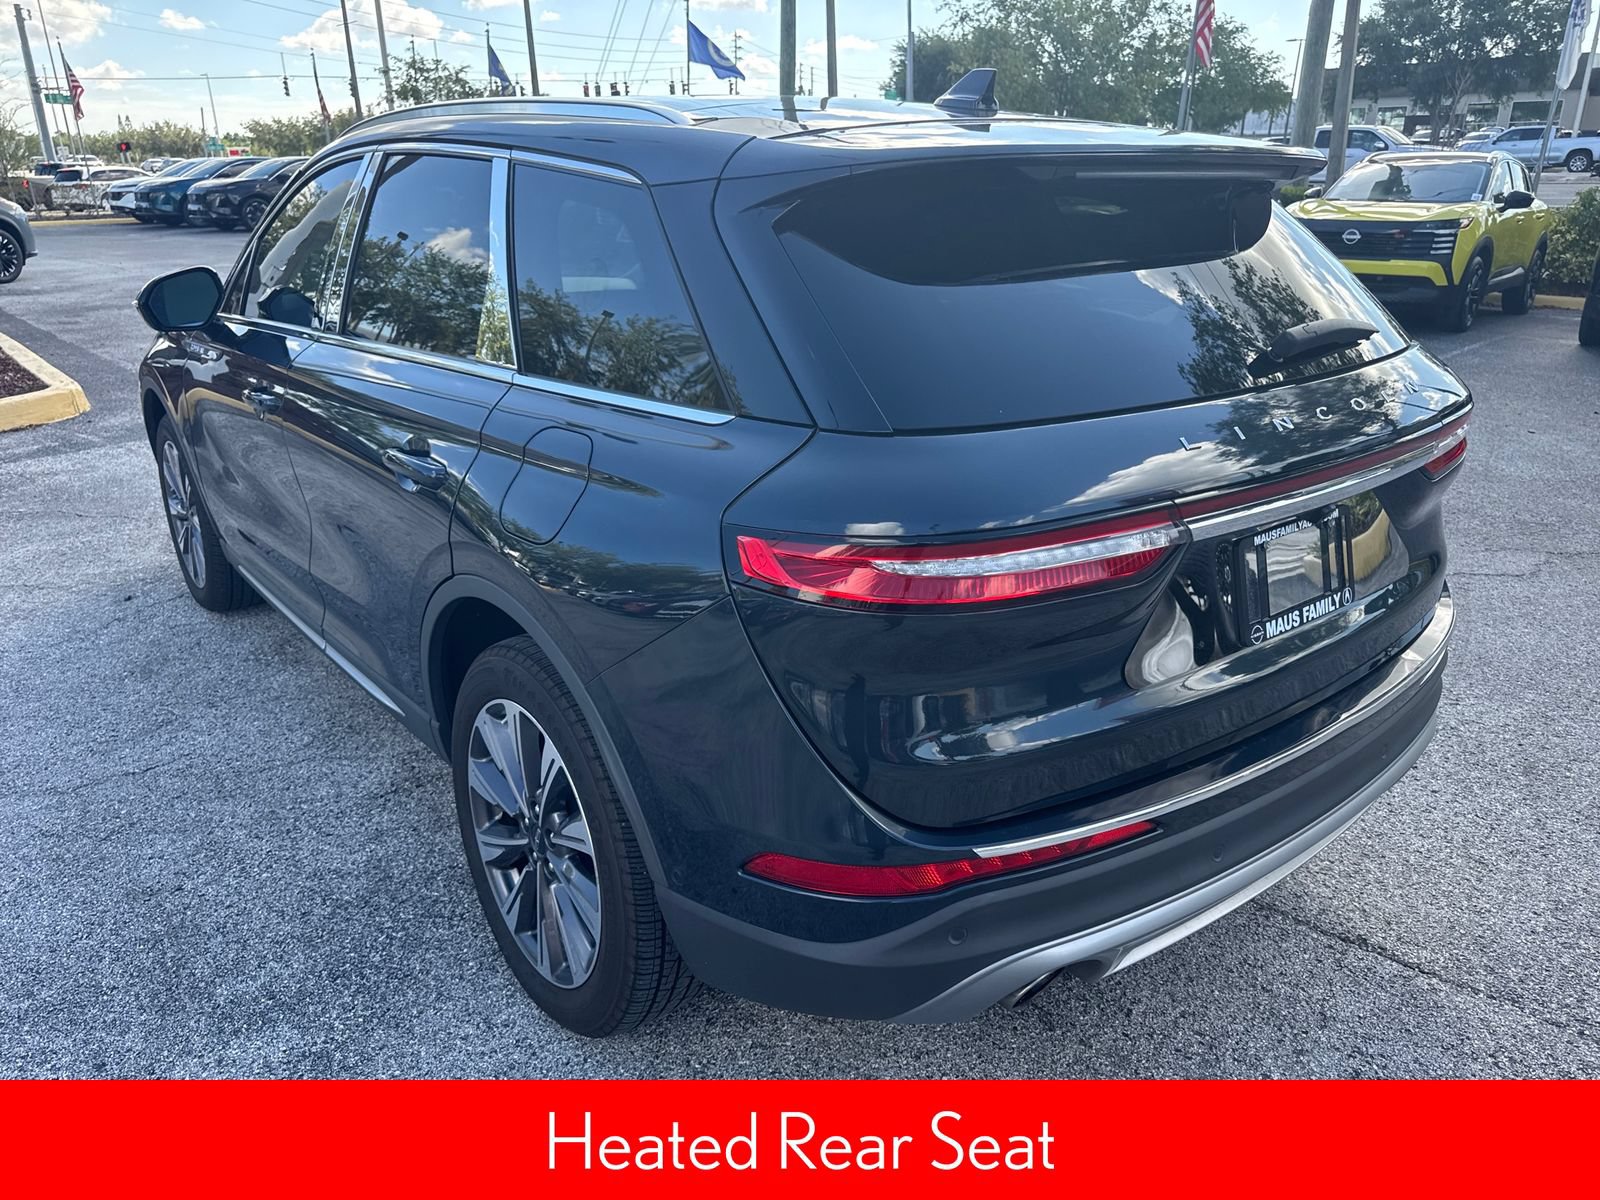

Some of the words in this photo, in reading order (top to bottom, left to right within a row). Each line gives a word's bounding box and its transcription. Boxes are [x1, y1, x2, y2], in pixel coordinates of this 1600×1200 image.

[1179, 381, 1419, 451] LINCOLN
[1265, 610, 1301, 639] MAUS
[1302, 592, 1341, 623] FAMILY
